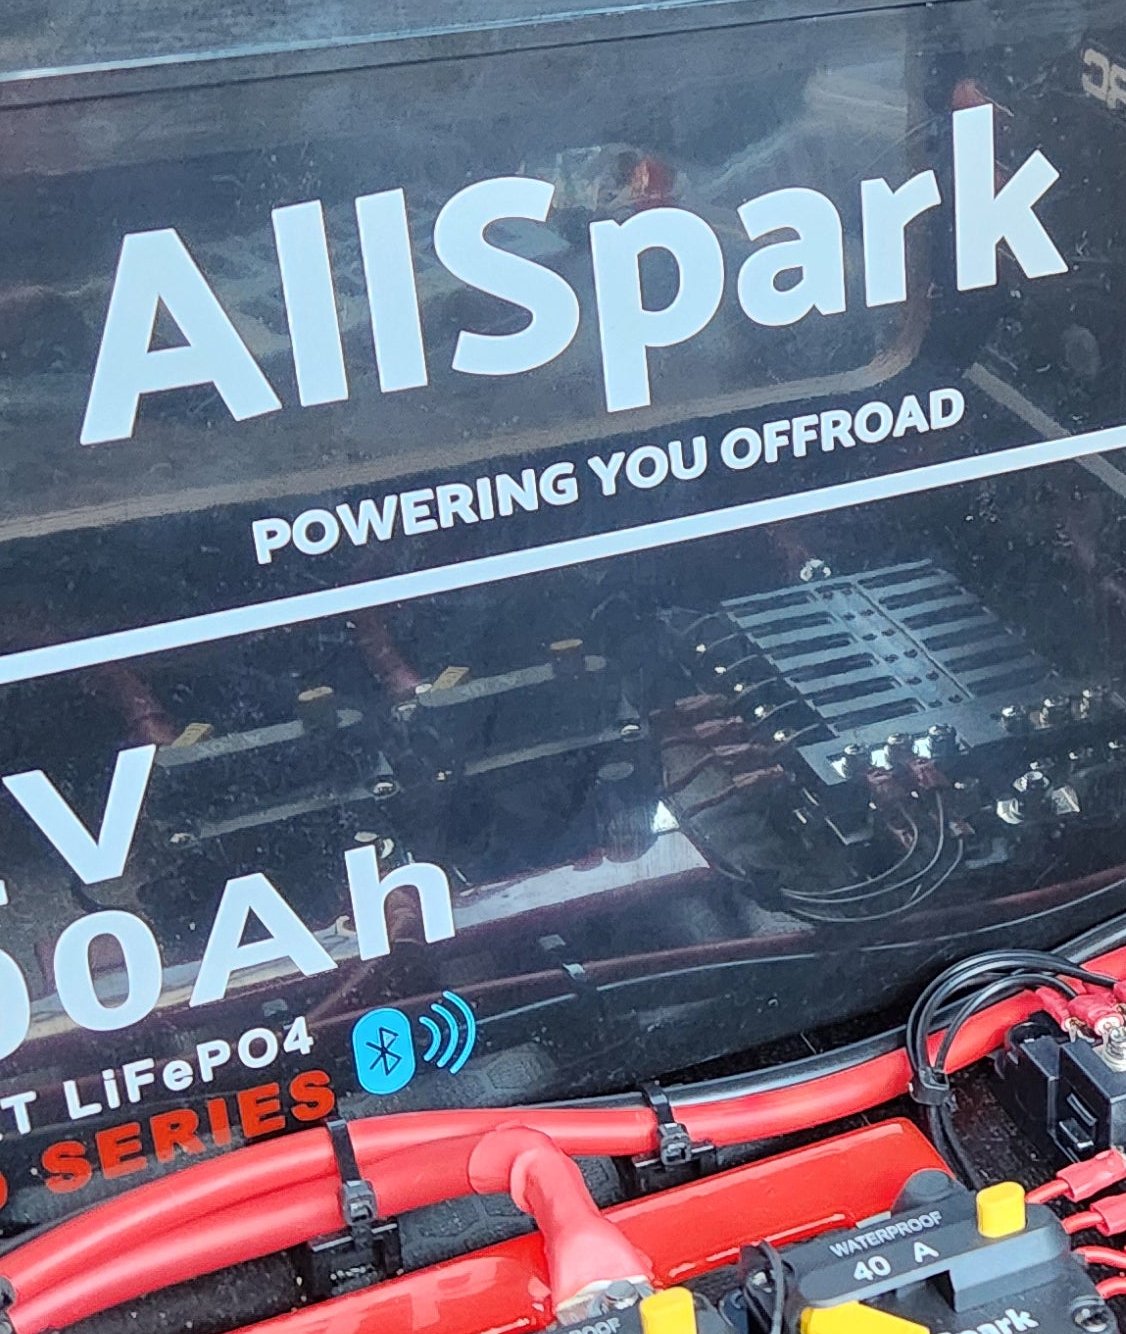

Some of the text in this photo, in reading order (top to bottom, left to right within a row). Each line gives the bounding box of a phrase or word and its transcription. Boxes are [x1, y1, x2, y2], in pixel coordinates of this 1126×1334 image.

[79, 102, 1069, 447] AllSpark
[252, 387, 965, 564] POWERING YOU OFFROAD
[0, 744, 157, 908] V
[0, 845, 456, 1061] 0Ah
[41, 1070, 337, 1195] SERIES
[63, 1016, 316, 1121] LiFePO4
[829, 1210, 942, 1257] WATERPROOF
[853, 1241, 940, 1281] 40 A
